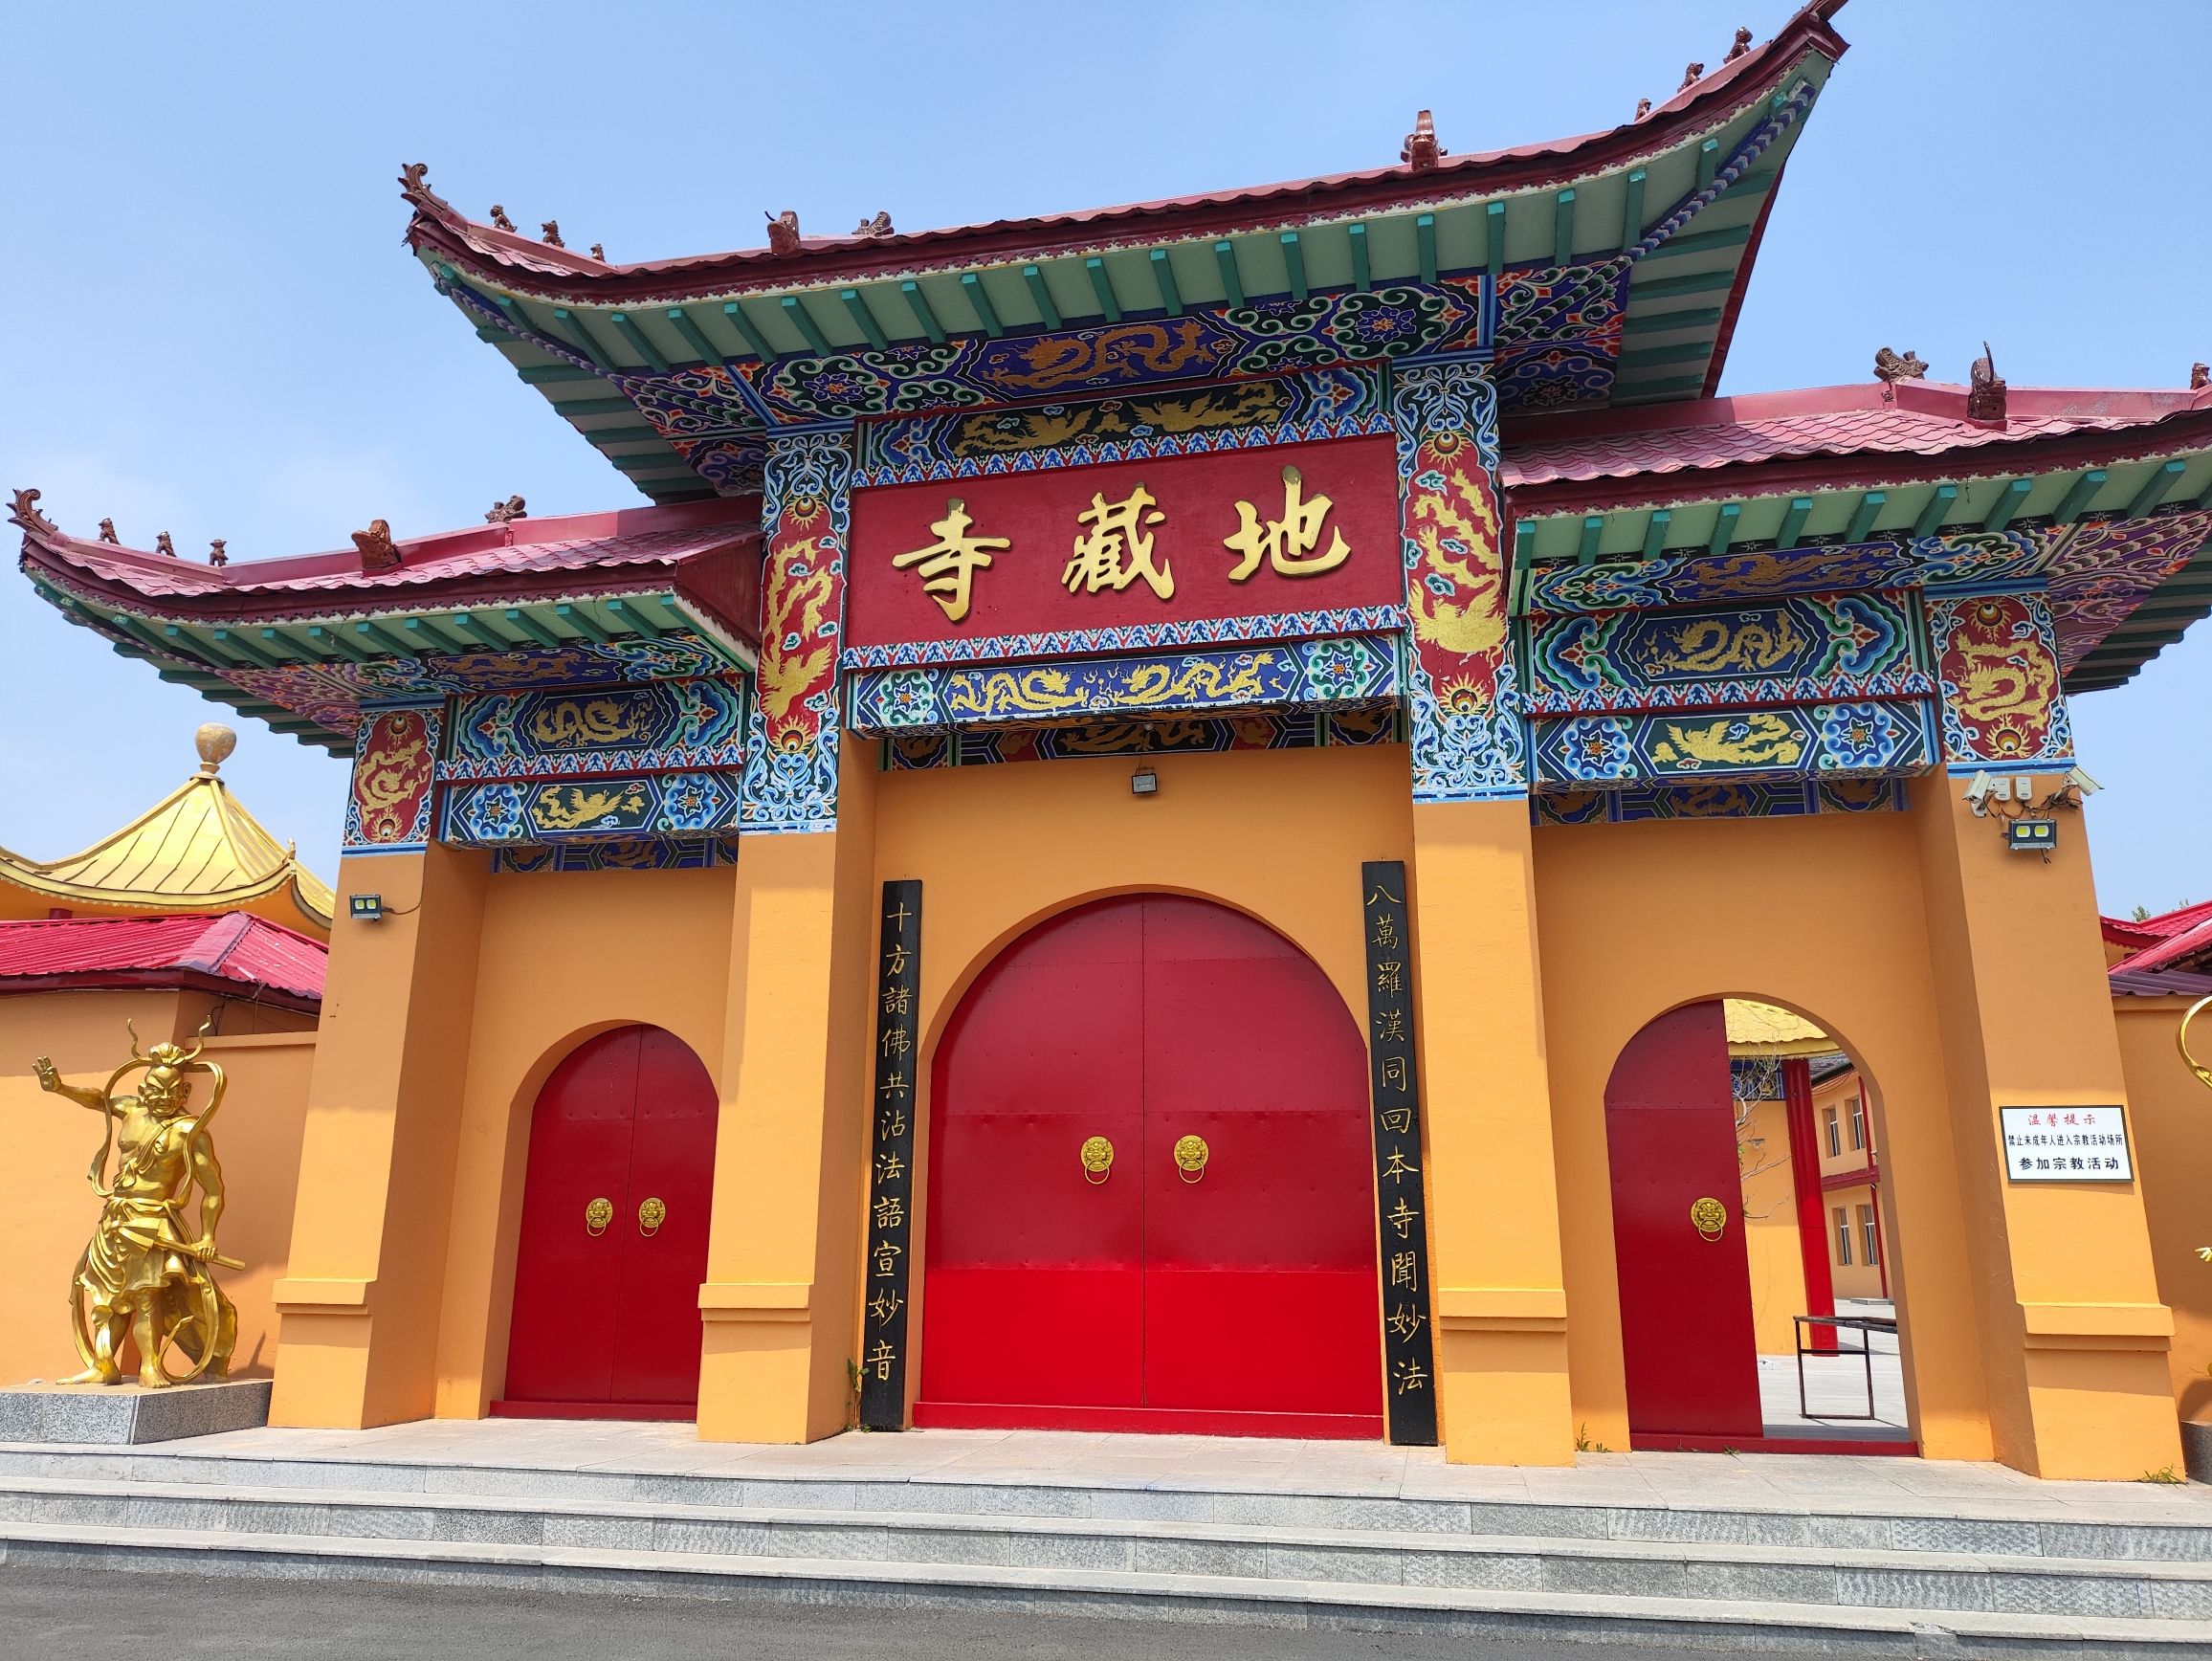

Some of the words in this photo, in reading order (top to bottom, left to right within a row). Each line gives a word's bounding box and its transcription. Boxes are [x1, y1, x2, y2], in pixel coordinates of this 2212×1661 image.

[2027, 1113, 2096, 1127] 温馨提示
[867, 902, 913, 1381] 十方諸佛共沾法語宣妙音
[1366, 885, 1428, 1395] 八萬羅漢同回本寺聞妙法
[2007, 1134, 2123, 1147] 禁止未成年人进入宗教活动场所
[2019, 1157, 2119, 1170] 参加宗教活动
